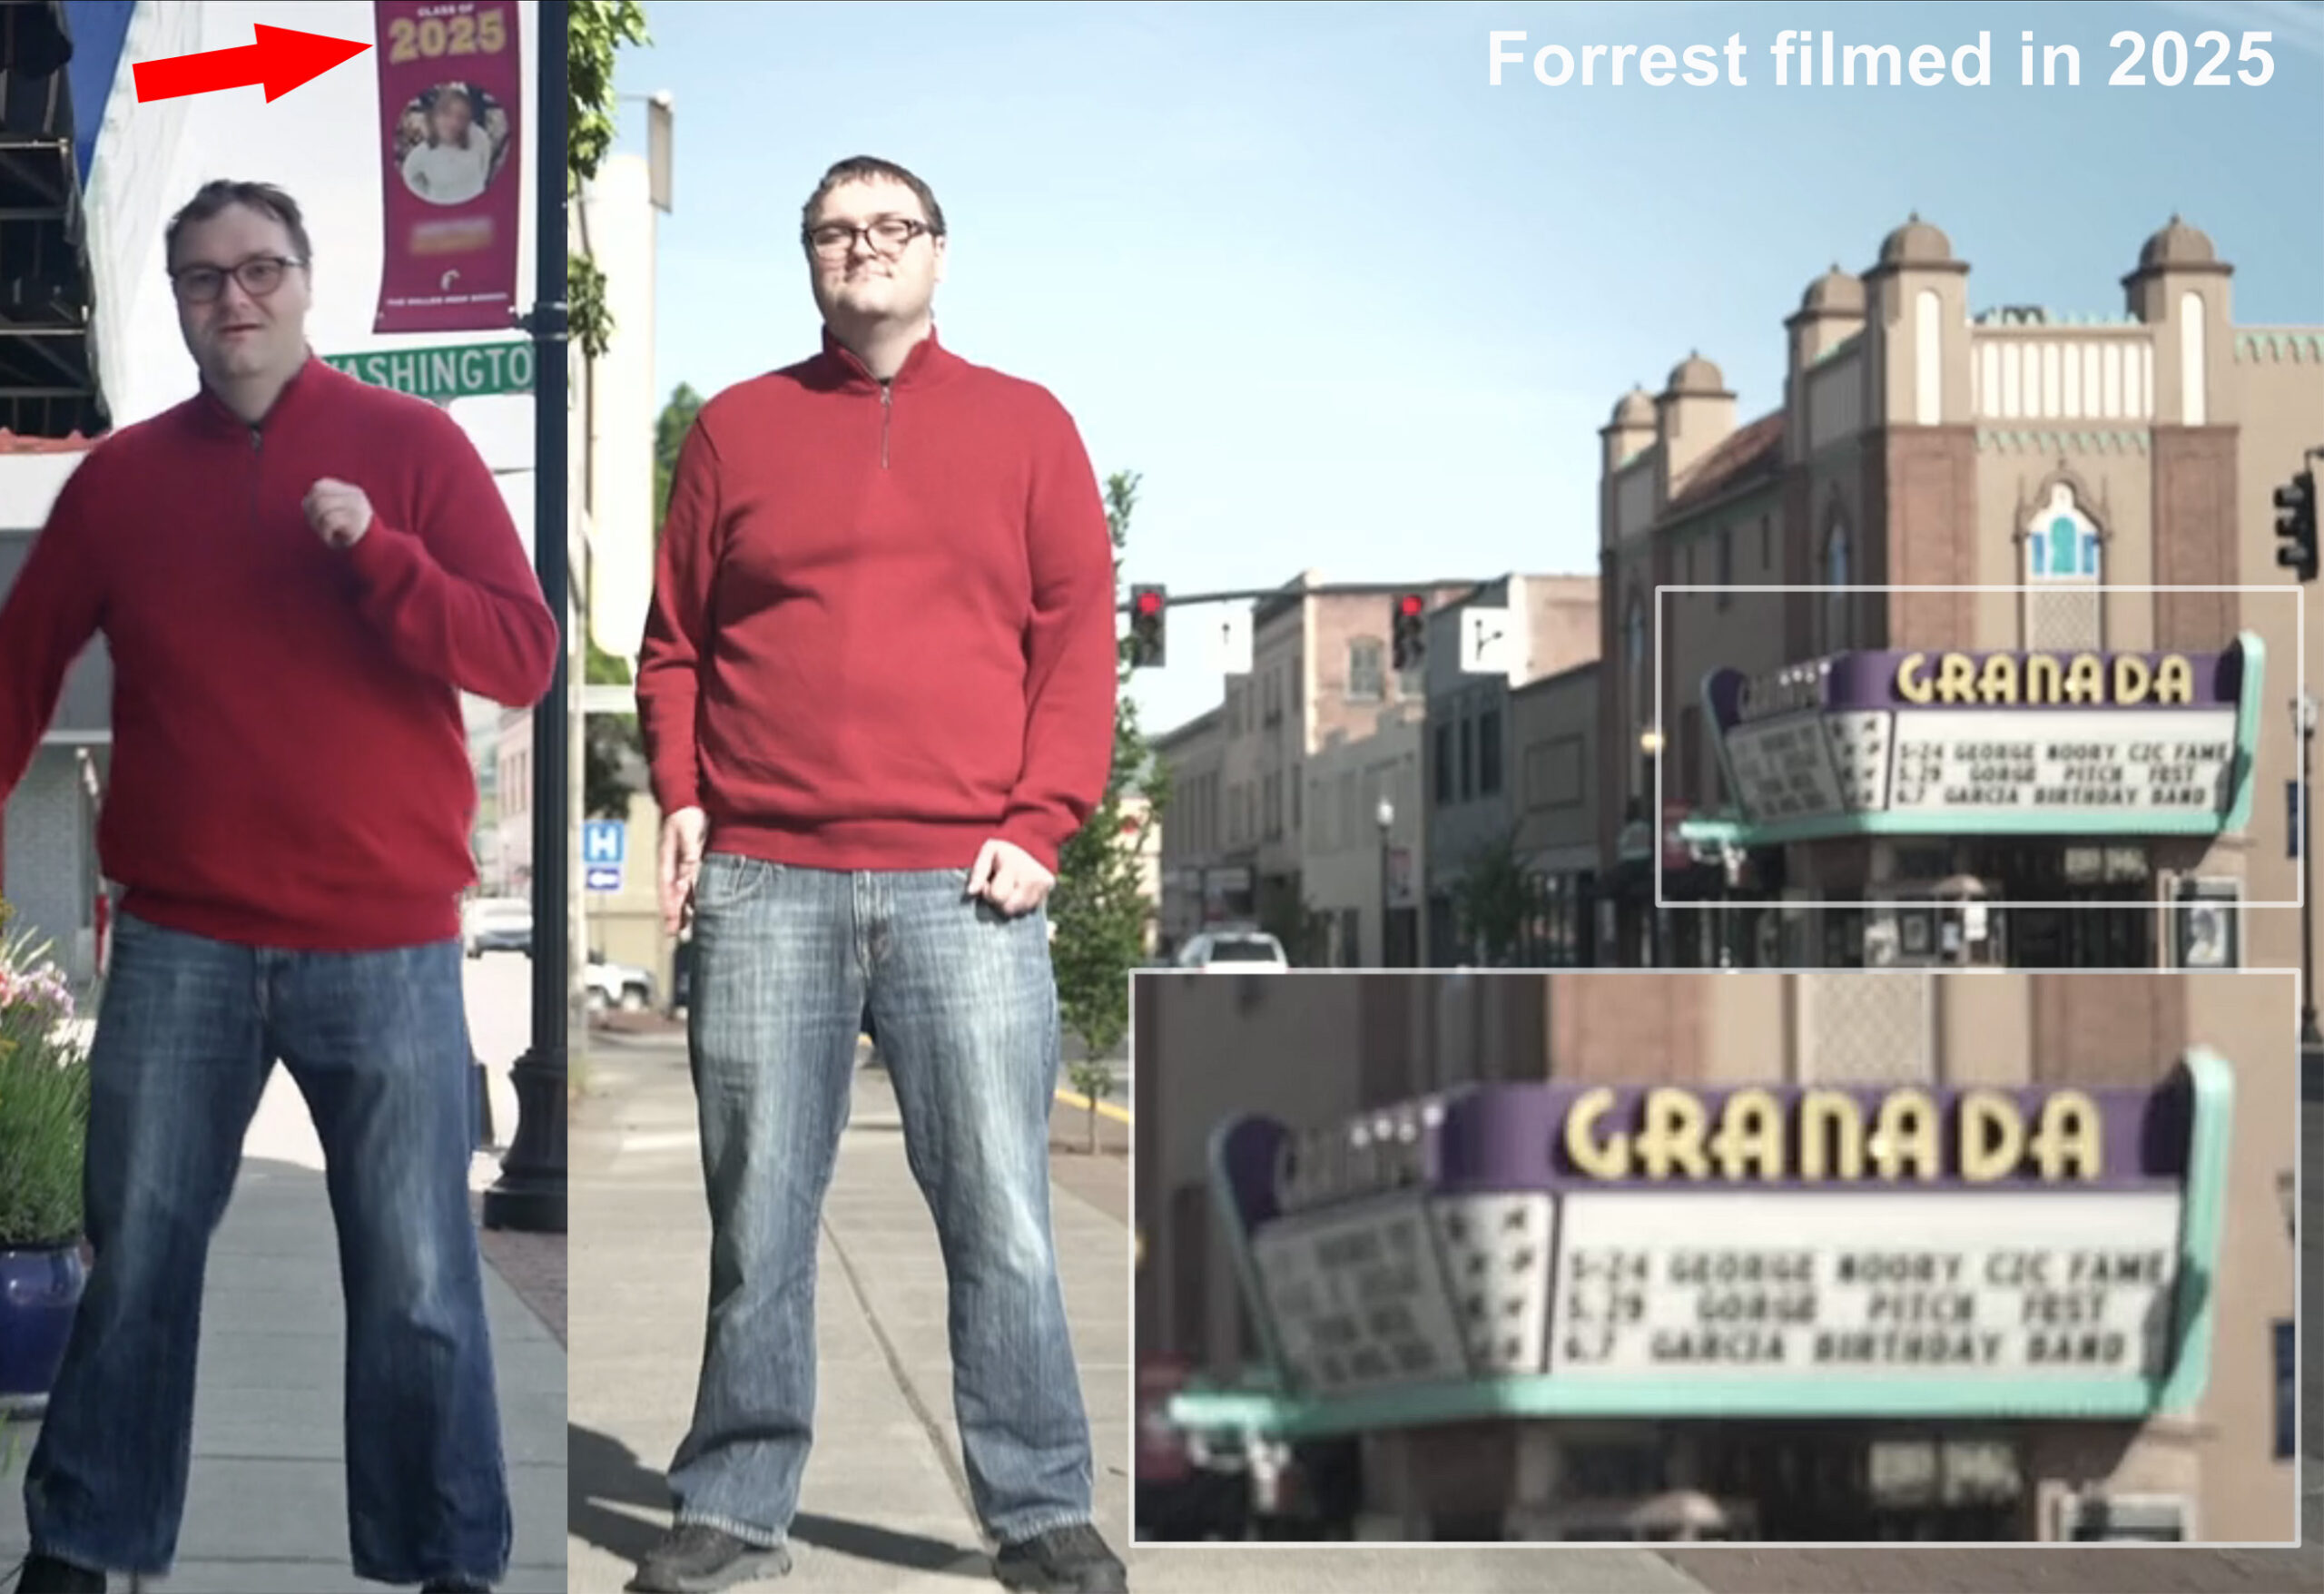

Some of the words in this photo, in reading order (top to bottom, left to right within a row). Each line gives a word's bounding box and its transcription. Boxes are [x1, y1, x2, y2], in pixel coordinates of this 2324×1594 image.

[388, 7, 507, 65] 2025
[330, 345, 533, 393] ASHINGTO
[1897, 652, 2193, 705] GRANADA
[1955, 742, 2034, 762] GEORGE
[1969, 764, 2036, 783] GORGE
[2063, 764, 2122, 783] PITCH
[2148, 764, 2196, 783] FEST
[1944, 787, 2018, 805] GARCIA
[2034, 786, 2138, 805] BIRTHDAY
[2151, 786, 2206, 805] BAND
[1566, 1088, 2102, 1181] GRANADA
[1669, 1251, 1814, 1284] GEORGE
[2068, 1251, 2164, 1283] FAME
[1695, 1291, 1817, 1323] GORGE
[1868, 1291, 1974, 1323] PITCH
[2021, 1291, 2106, 1323] FEST
[1650, 1330, 1786, 1361] GARCIA
[1816, 1330, 1999, 1361] BIRTHDAY
[2027, 1330, 2125, 1362] BAND
